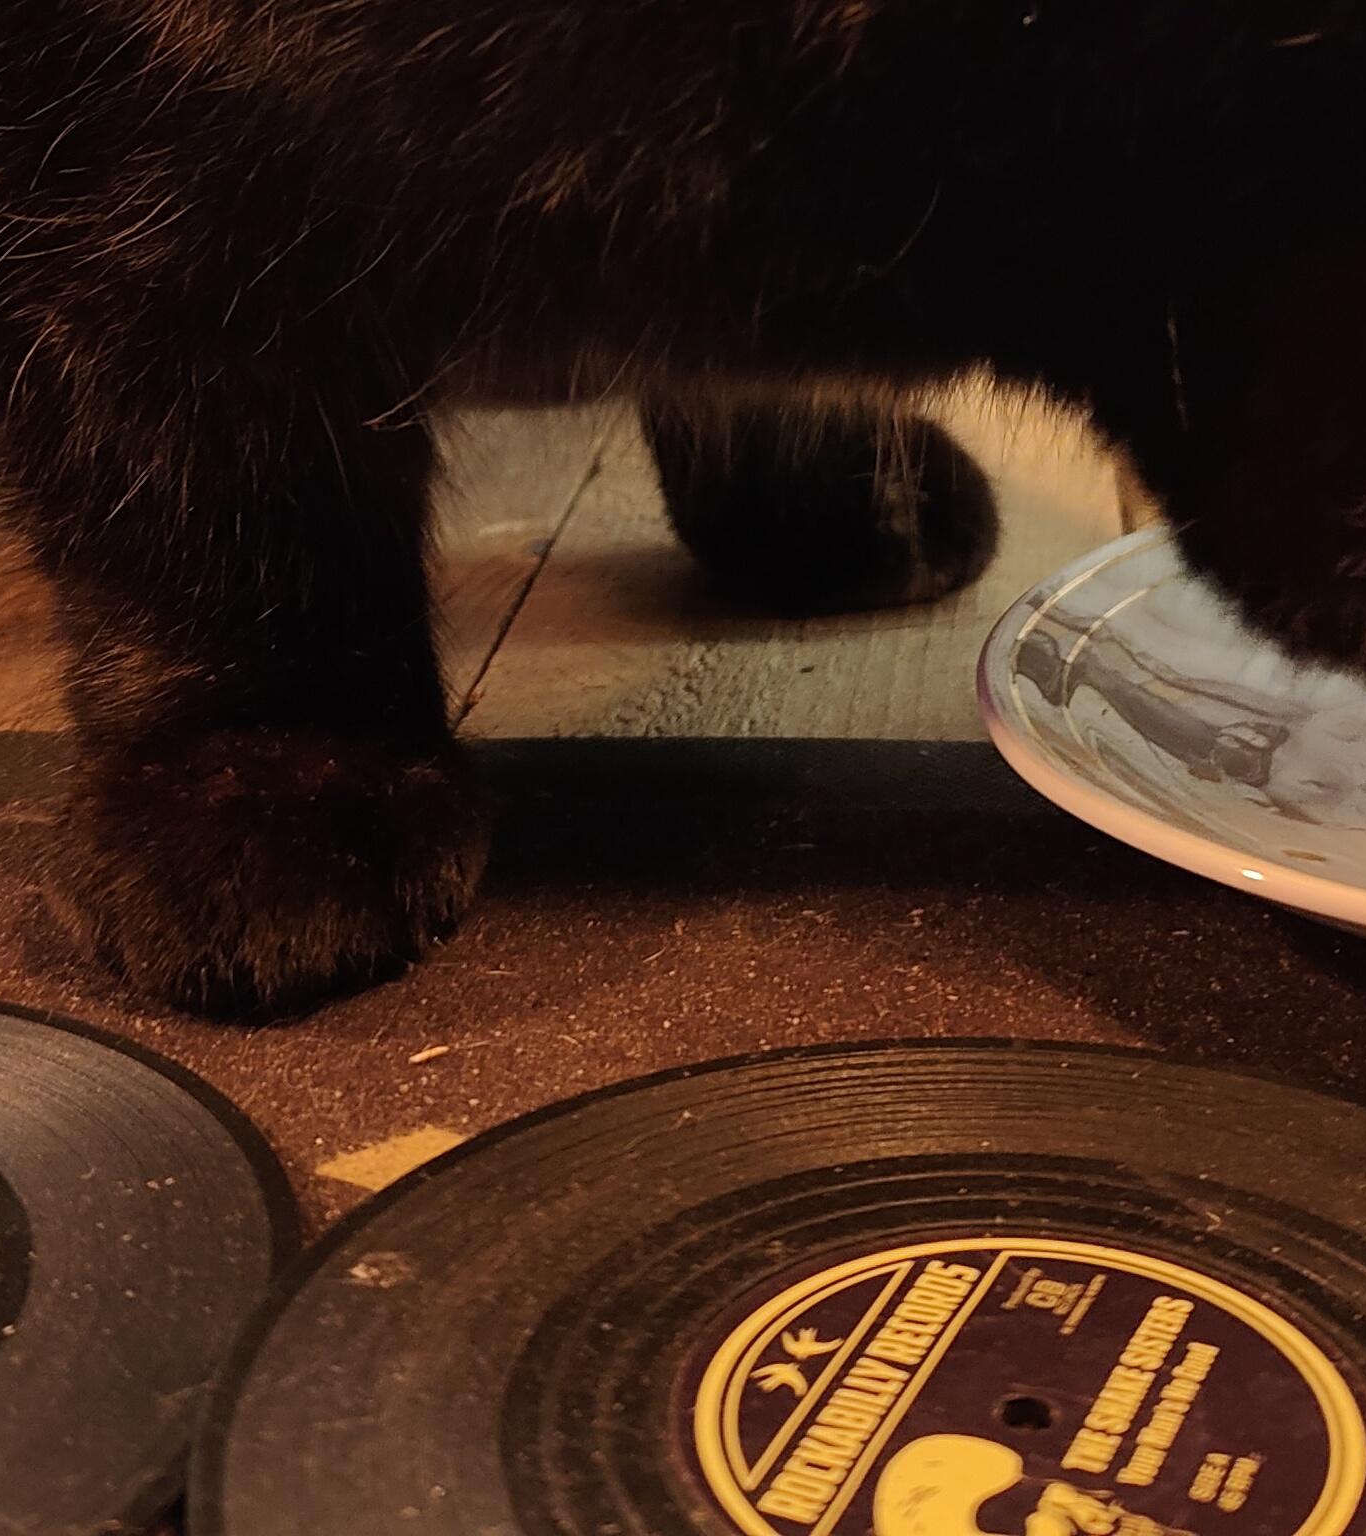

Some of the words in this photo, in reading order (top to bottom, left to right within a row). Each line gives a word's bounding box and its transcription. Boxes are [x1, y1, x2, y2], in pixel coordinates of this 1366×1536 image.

[756, 1357, 911, 1524] ROCKABILLY
[865, 1259, 982, 1366] RECORDS
[1060, 1427, 1123, 1474] THE
[1119, 1295, 1195, 1370] SISTERS
